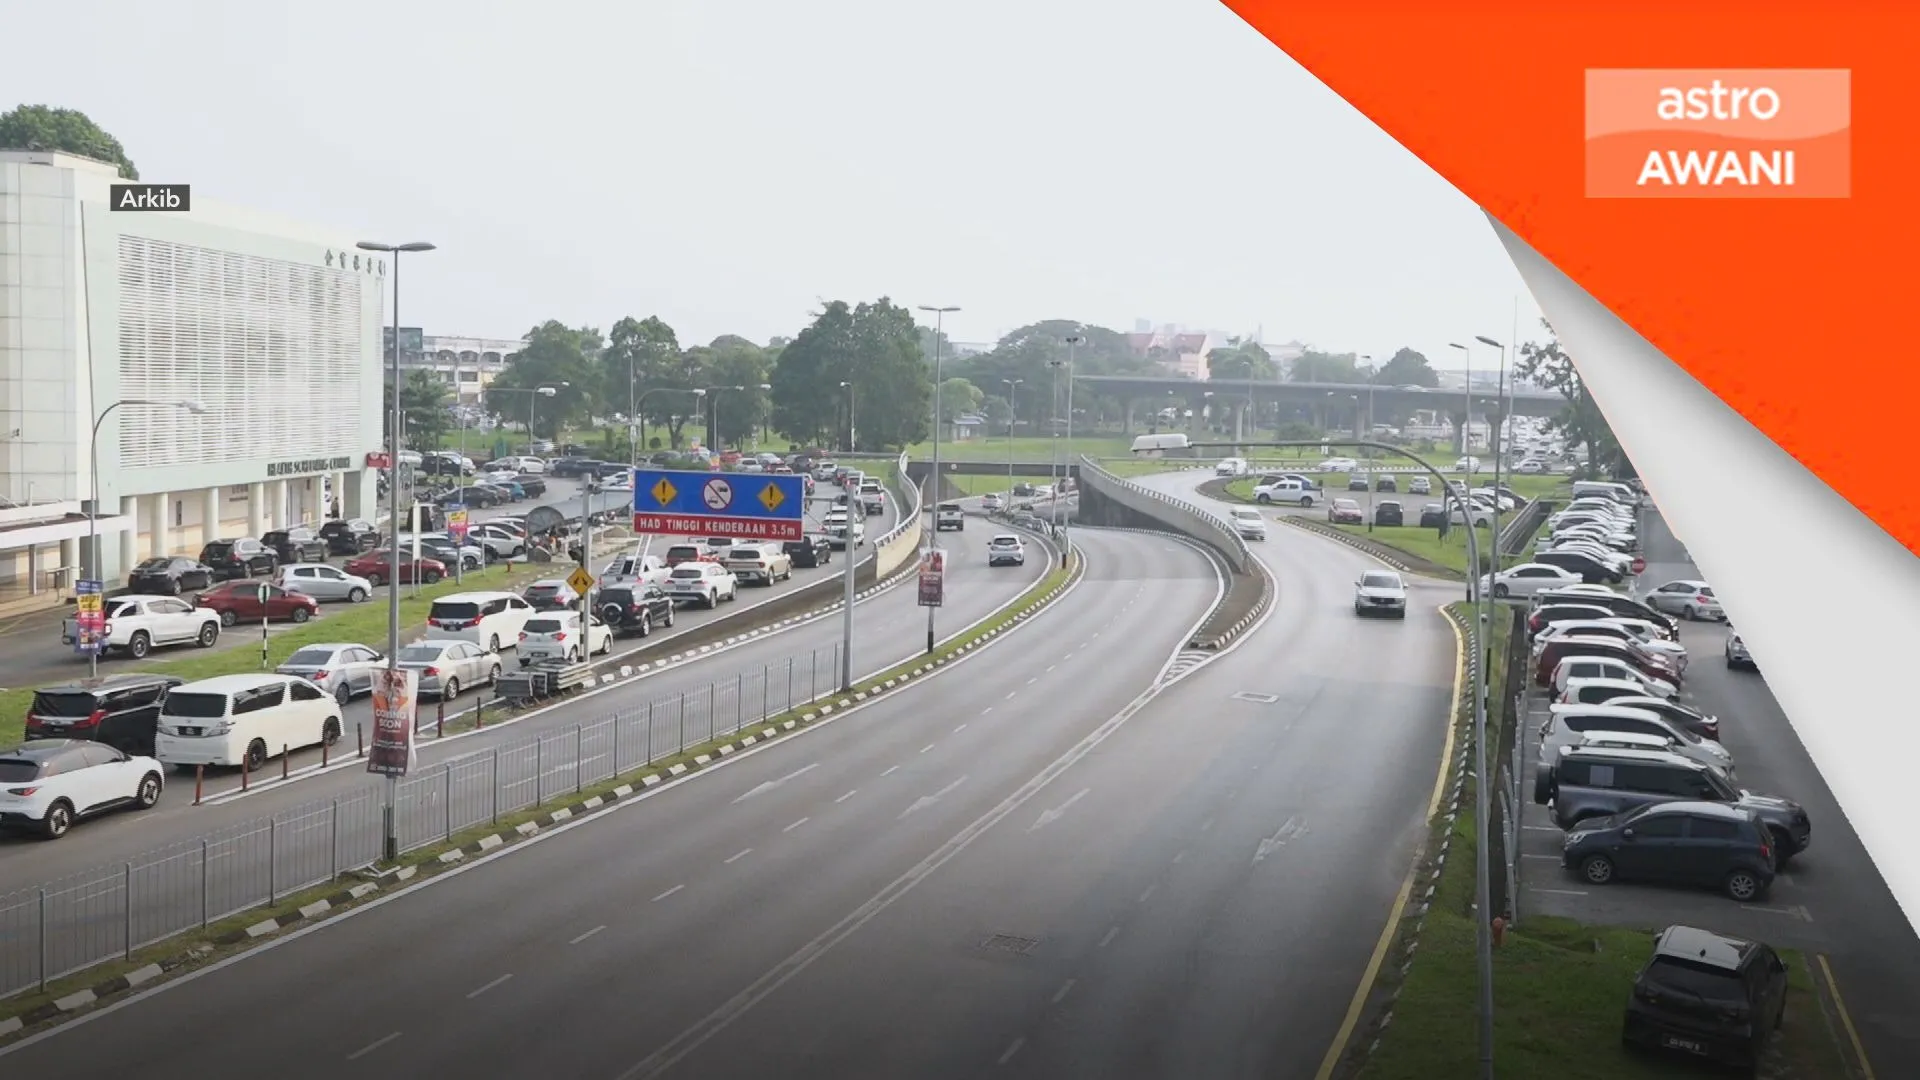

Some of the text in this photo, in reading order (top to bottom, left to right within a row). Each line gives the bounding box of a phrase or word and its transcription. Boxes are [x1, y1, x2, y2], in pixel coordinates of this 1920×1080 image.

[640, 517, 795, 536] HAD TINGGI KENDERAAN 3.5m
